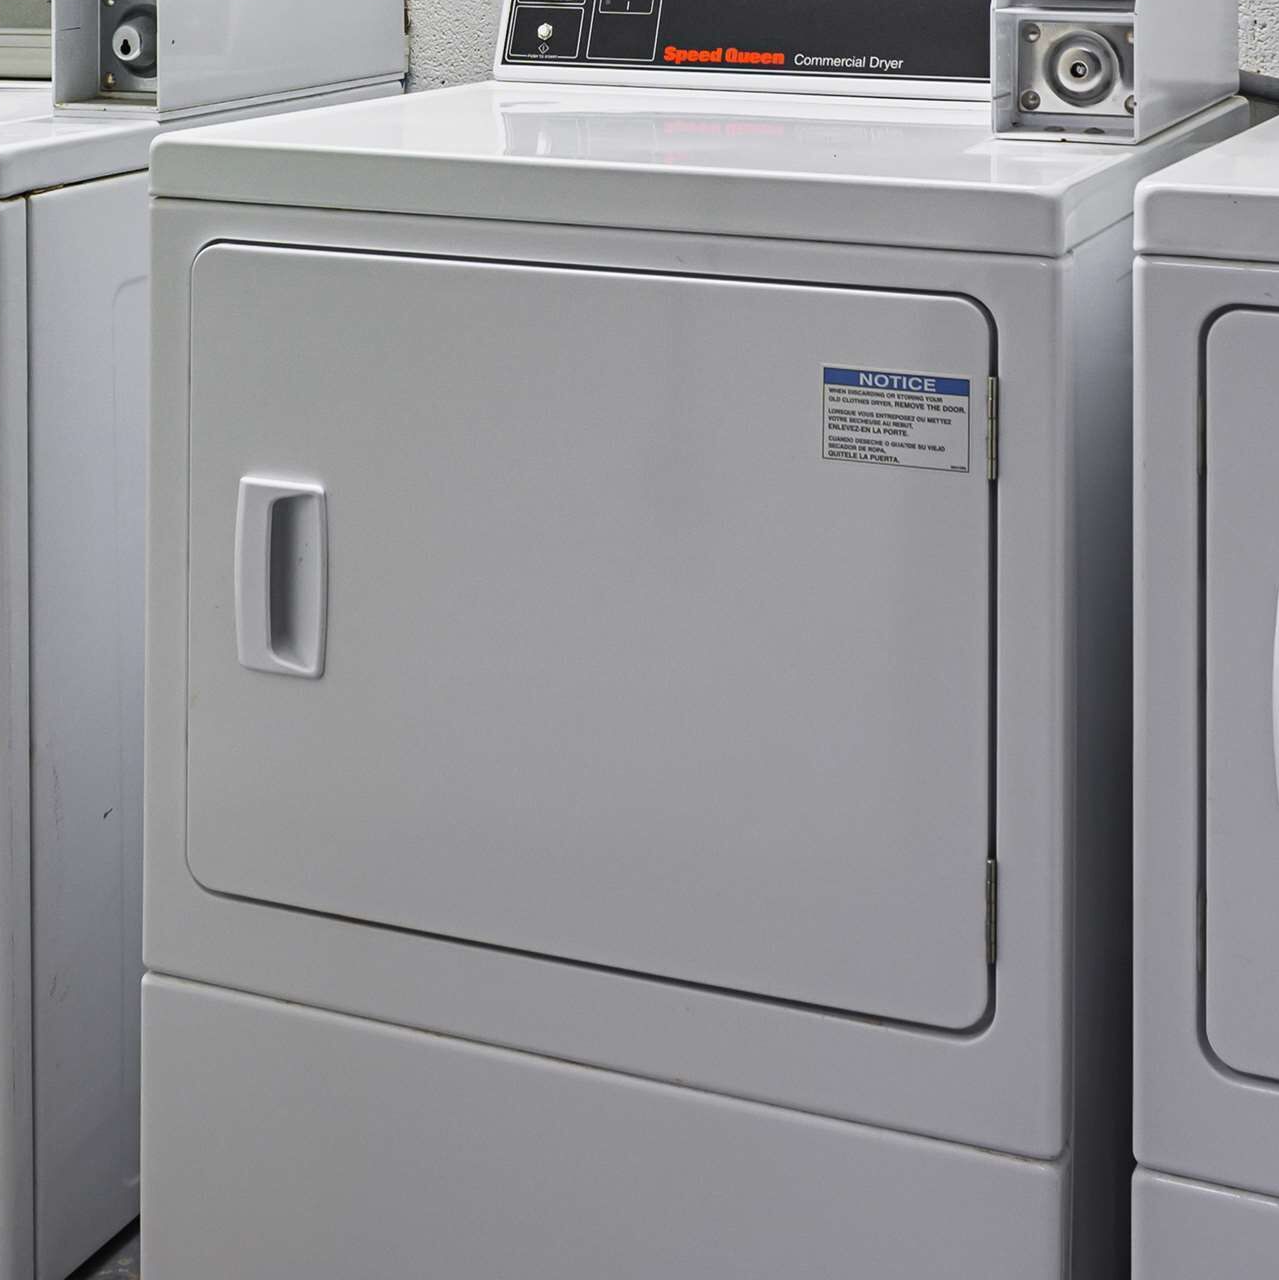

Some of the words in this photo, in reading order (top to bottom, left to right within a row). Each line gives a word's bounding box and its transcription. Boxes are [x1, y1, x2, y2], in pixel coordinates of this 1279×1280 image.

[663, 46, 722, 64] Speed
[725, 48, 785, 65] Queen
[794, 53, 866, 68] Commercial
[869, 56, 903, 71] Dryer
[859, 372, 936, 392] NOTICE
[895, 401, 924, 410] REMOVE
[872, 426, 881, 434] LA
[828, 450, 857, 458] QUITELE
